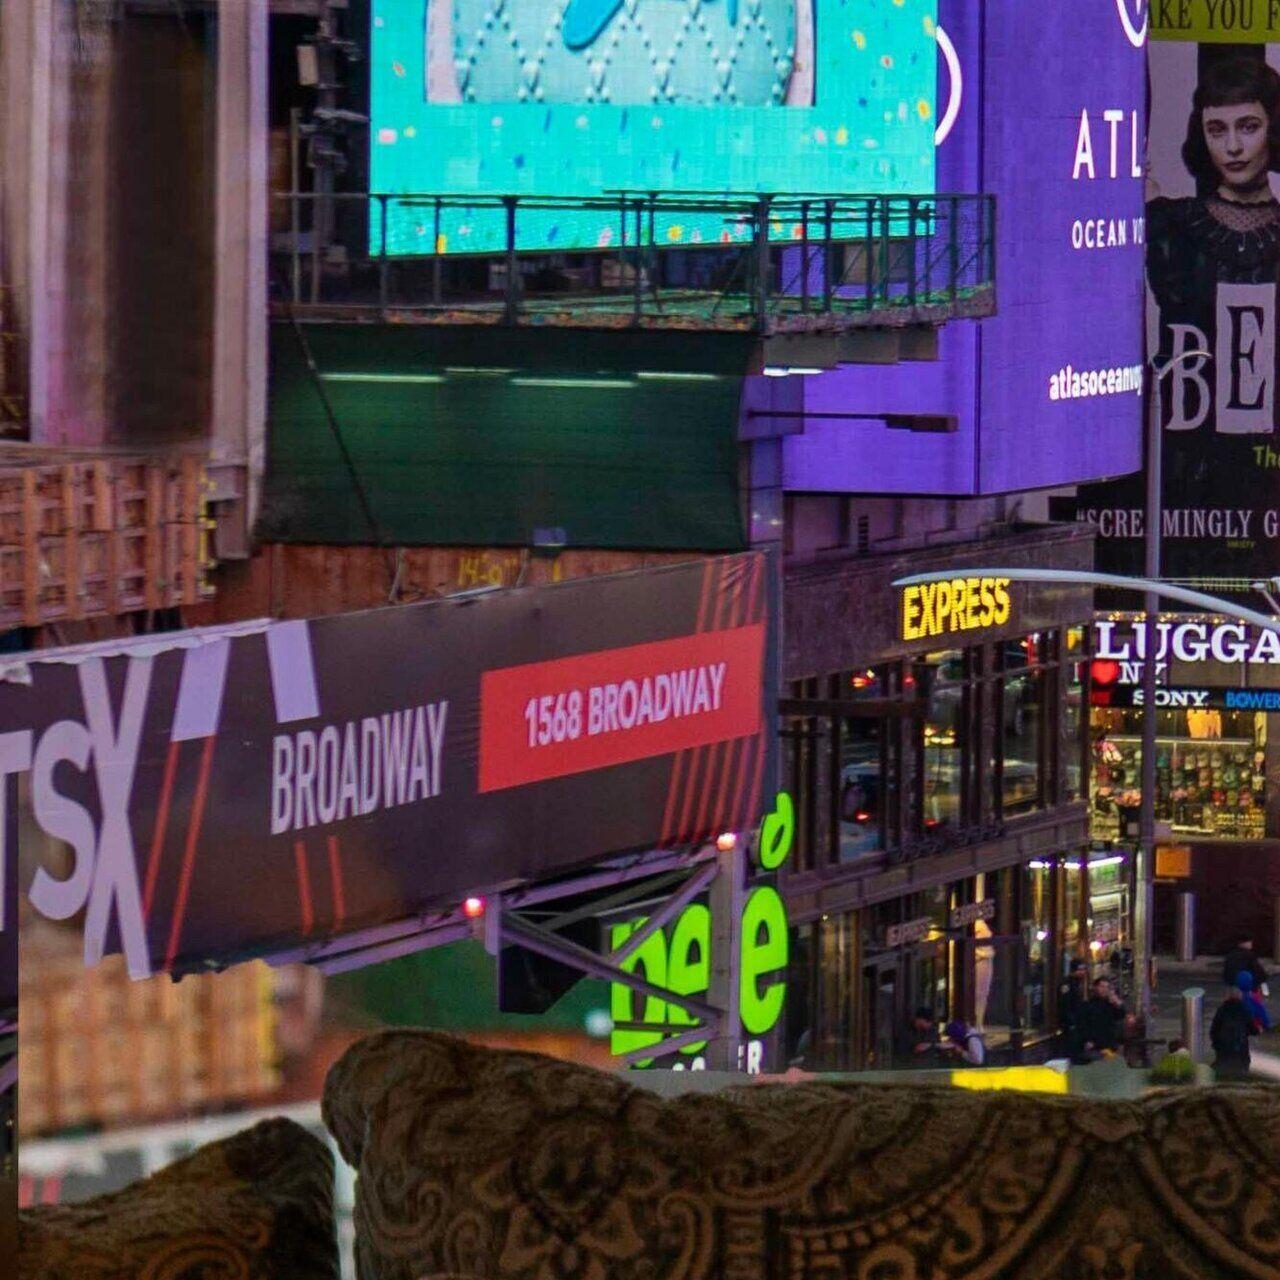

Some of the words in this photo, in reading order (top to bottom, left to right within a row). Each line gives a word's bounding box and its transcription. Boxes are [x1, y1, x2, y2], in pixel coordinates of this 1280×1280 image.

[1071, 218, 1128, 249] OCEAN
[903, 577, 1011, 641] EXPRESS
[524, 689, 583, 748] 1568
[587, 662, 727, 736] BROADWAY
[271, 700, 449, 836] BROADWAY
